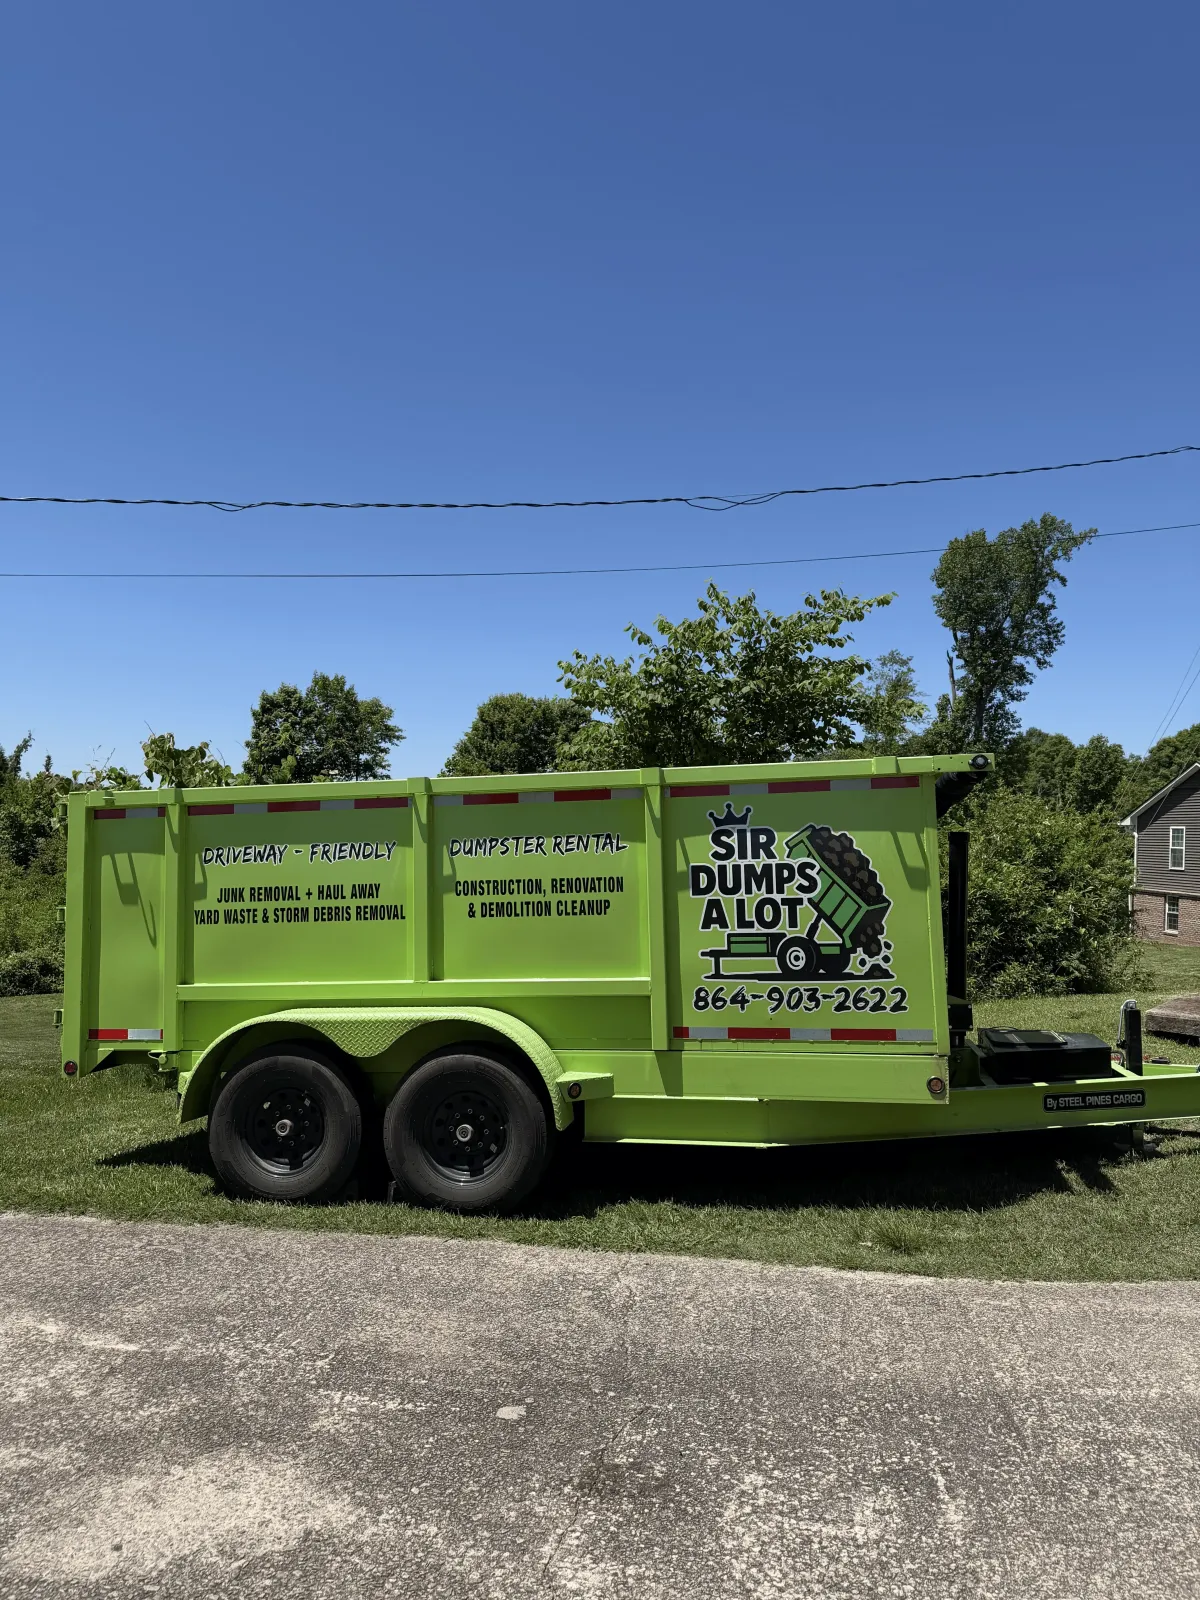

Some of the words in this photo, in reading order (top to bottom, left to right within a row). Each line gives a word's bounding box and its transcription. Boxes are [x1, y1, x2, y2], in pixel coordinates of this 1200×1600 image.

[203, 845, 288, 867] DRIVEWAY
[309, 841, 397, 863] FRIENDLY
[450, 836, 547, 857] DUMPSTER
[552, 833, 628, 855] RENTAL
[710, 828, 777, 861] SIR
[455, 878, 546, 897] CONSTRUCTION,
[551, 876, 624, 894] RENOVATION
[690, 862, 820, 897] DUMPS
[217, 887, 245, 903] JUNK
[250, 885, 300, 902] REMOVAL
[306, 889, 313, 899] +
[318, 884, 346, 900] HAUL
[351, 883, 381, 899] AWAY
[194, 909, 220, 925] YARD
[224, 908, 258, 924] WASTE
[262, 908, 270, 923] &
[274, 907, 310, 923] STORM
[314, 906, 351, 922] DEBRIS
[356, 904, 406, 920] REMOVAL
[468, 902, 476, 918] &
[480, 900, 551, 918] DEMOLITION
[556, 899, 611, 916] CLEANUP
[700, 898, 730, 930] A
[735, 897, 804, 930] LOT
[692, 985, 909, 1013] 864-903-2622
[1046, 1098, 1057, 1109] By
[1058, 1096, 1084, 1107] STEEL
[1086, 1095, 1112, 1106] PINES
[1112, 1093, 1142, 1104] CARGO
